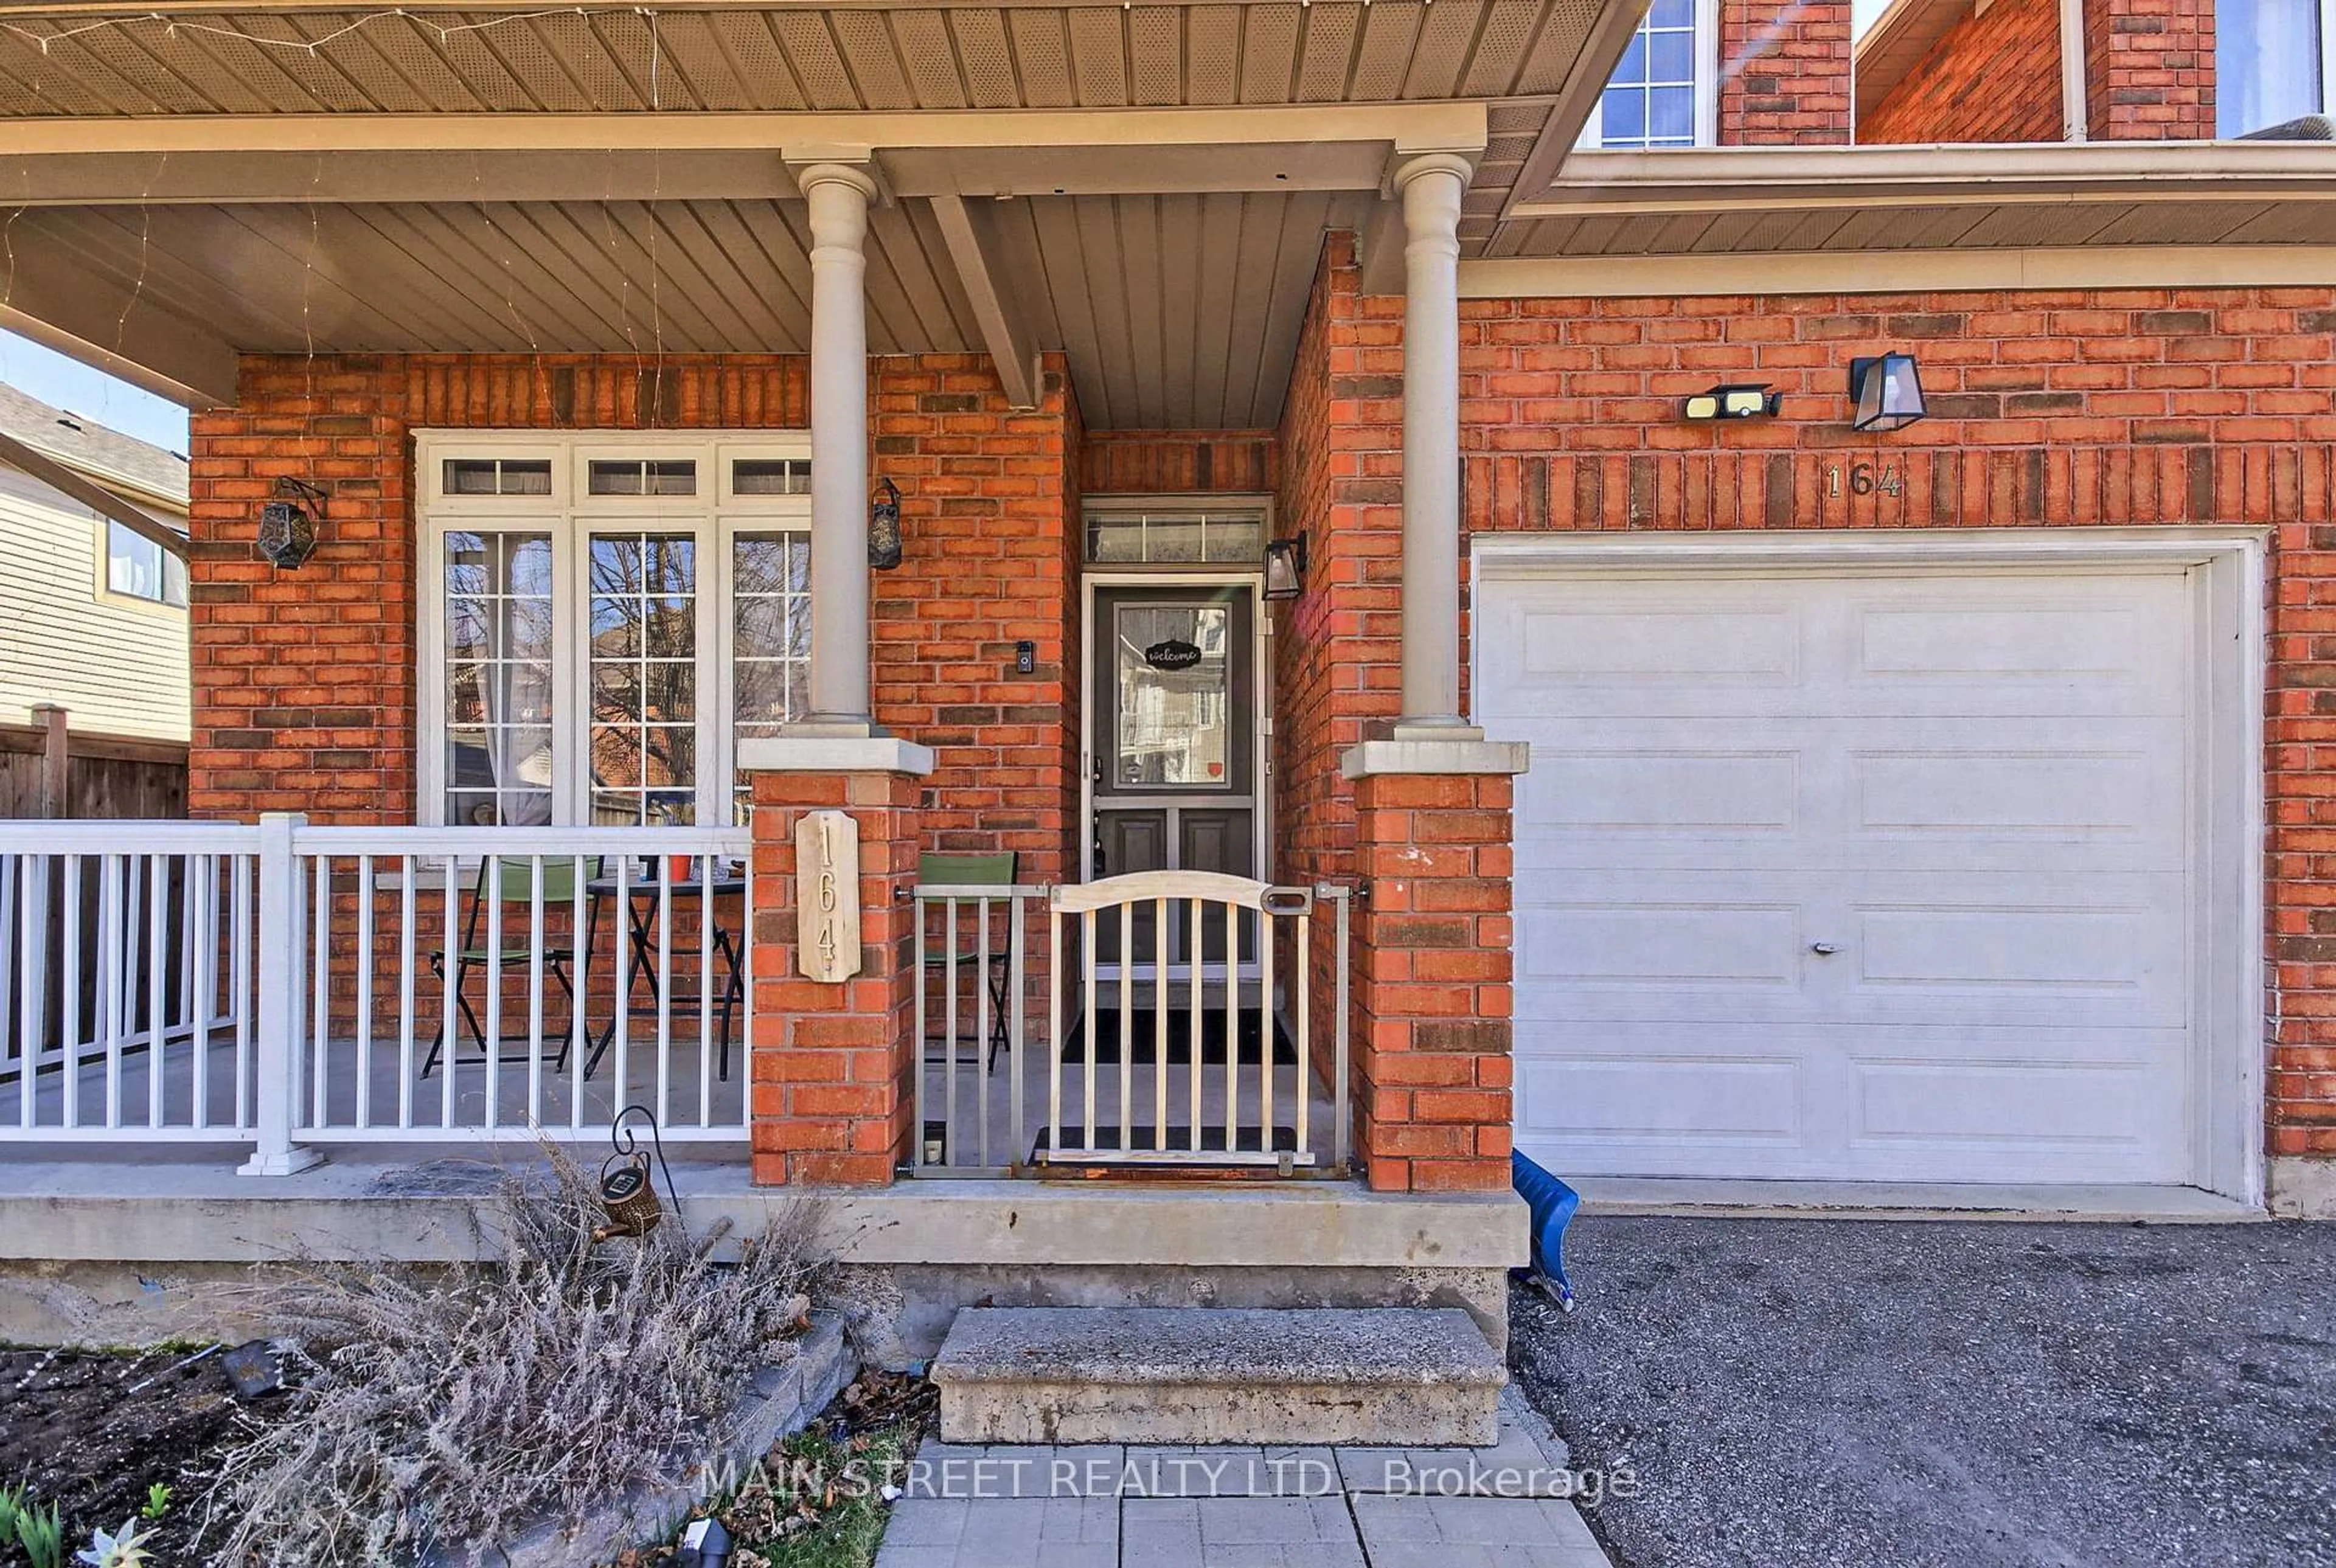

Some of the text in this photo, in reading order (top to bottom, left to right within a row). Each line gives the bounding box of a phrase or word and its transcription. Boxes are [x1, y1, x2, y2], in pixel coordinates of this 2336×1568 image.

[1827, 463, 1902, 498] 164
[1149, 648, 1197, 661] welcome
[817, 825, 835, 961] 164
